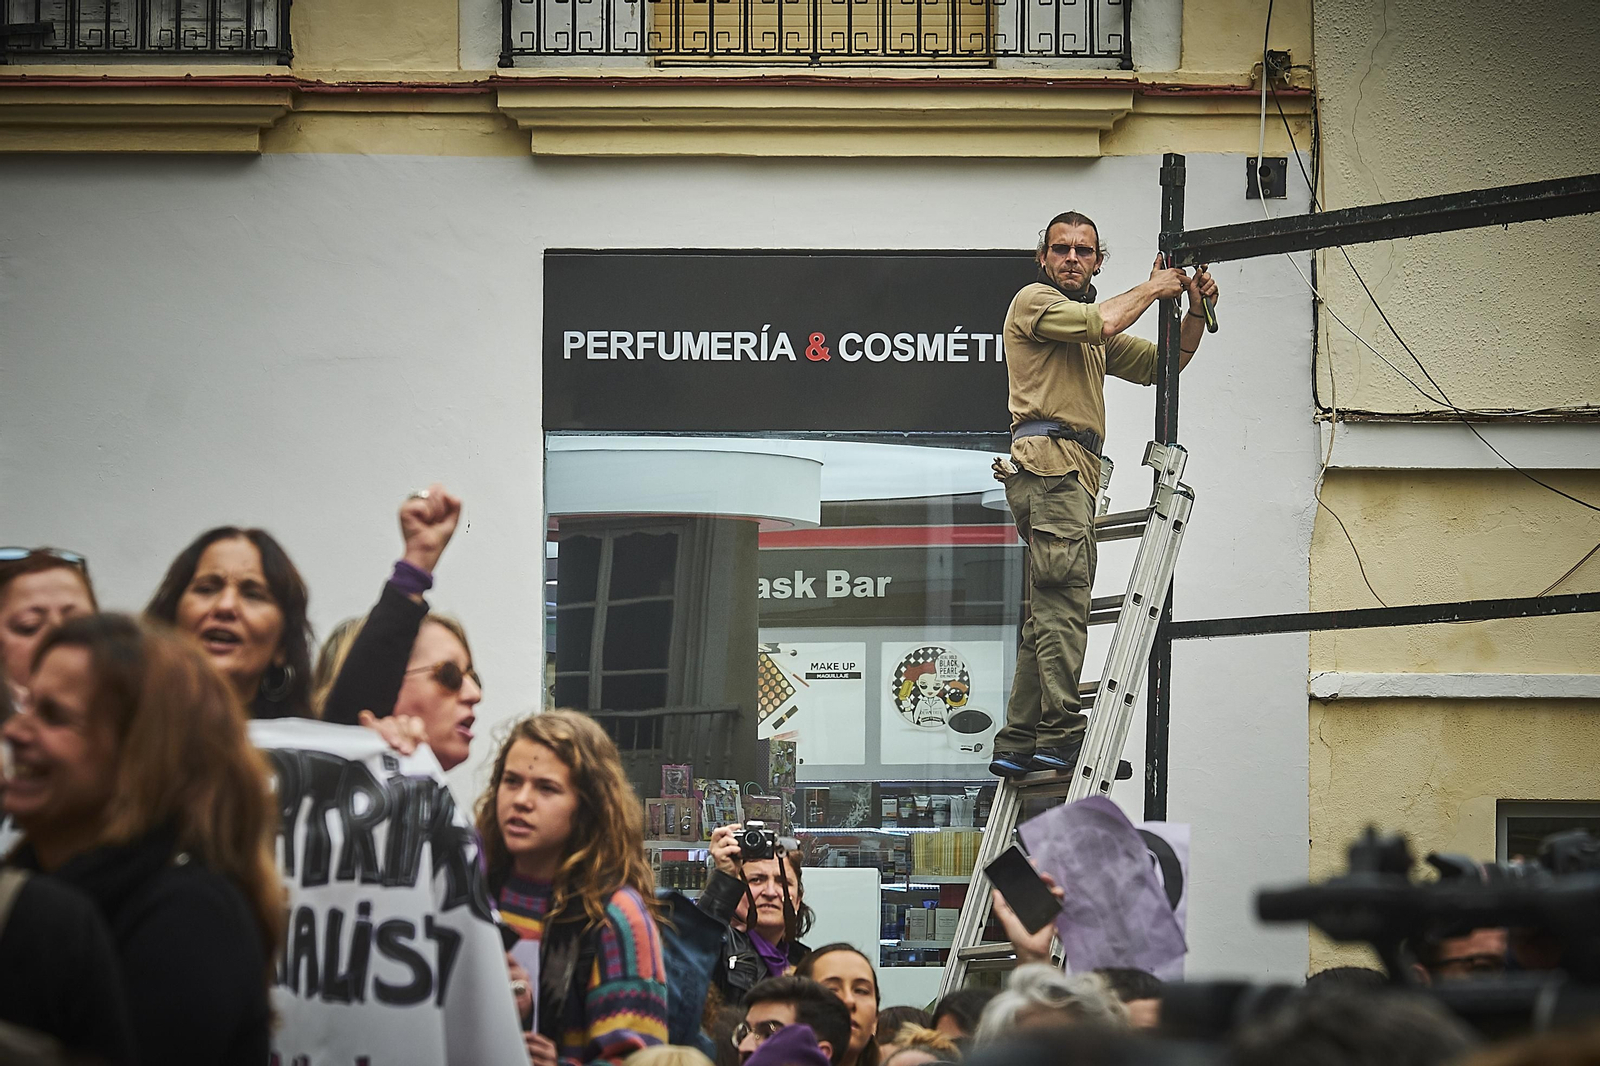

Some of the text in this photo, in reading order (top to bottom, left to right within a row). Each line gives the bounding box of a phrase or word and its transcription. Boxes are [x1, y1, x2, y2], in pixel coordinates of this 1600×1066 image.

[562, 323, 797, 362] PERFUMERÍA
[804, 331, 832, 362] &
[826, 569, 893, 598] Bar
[810, 662, 856, 671] MAKE UP
